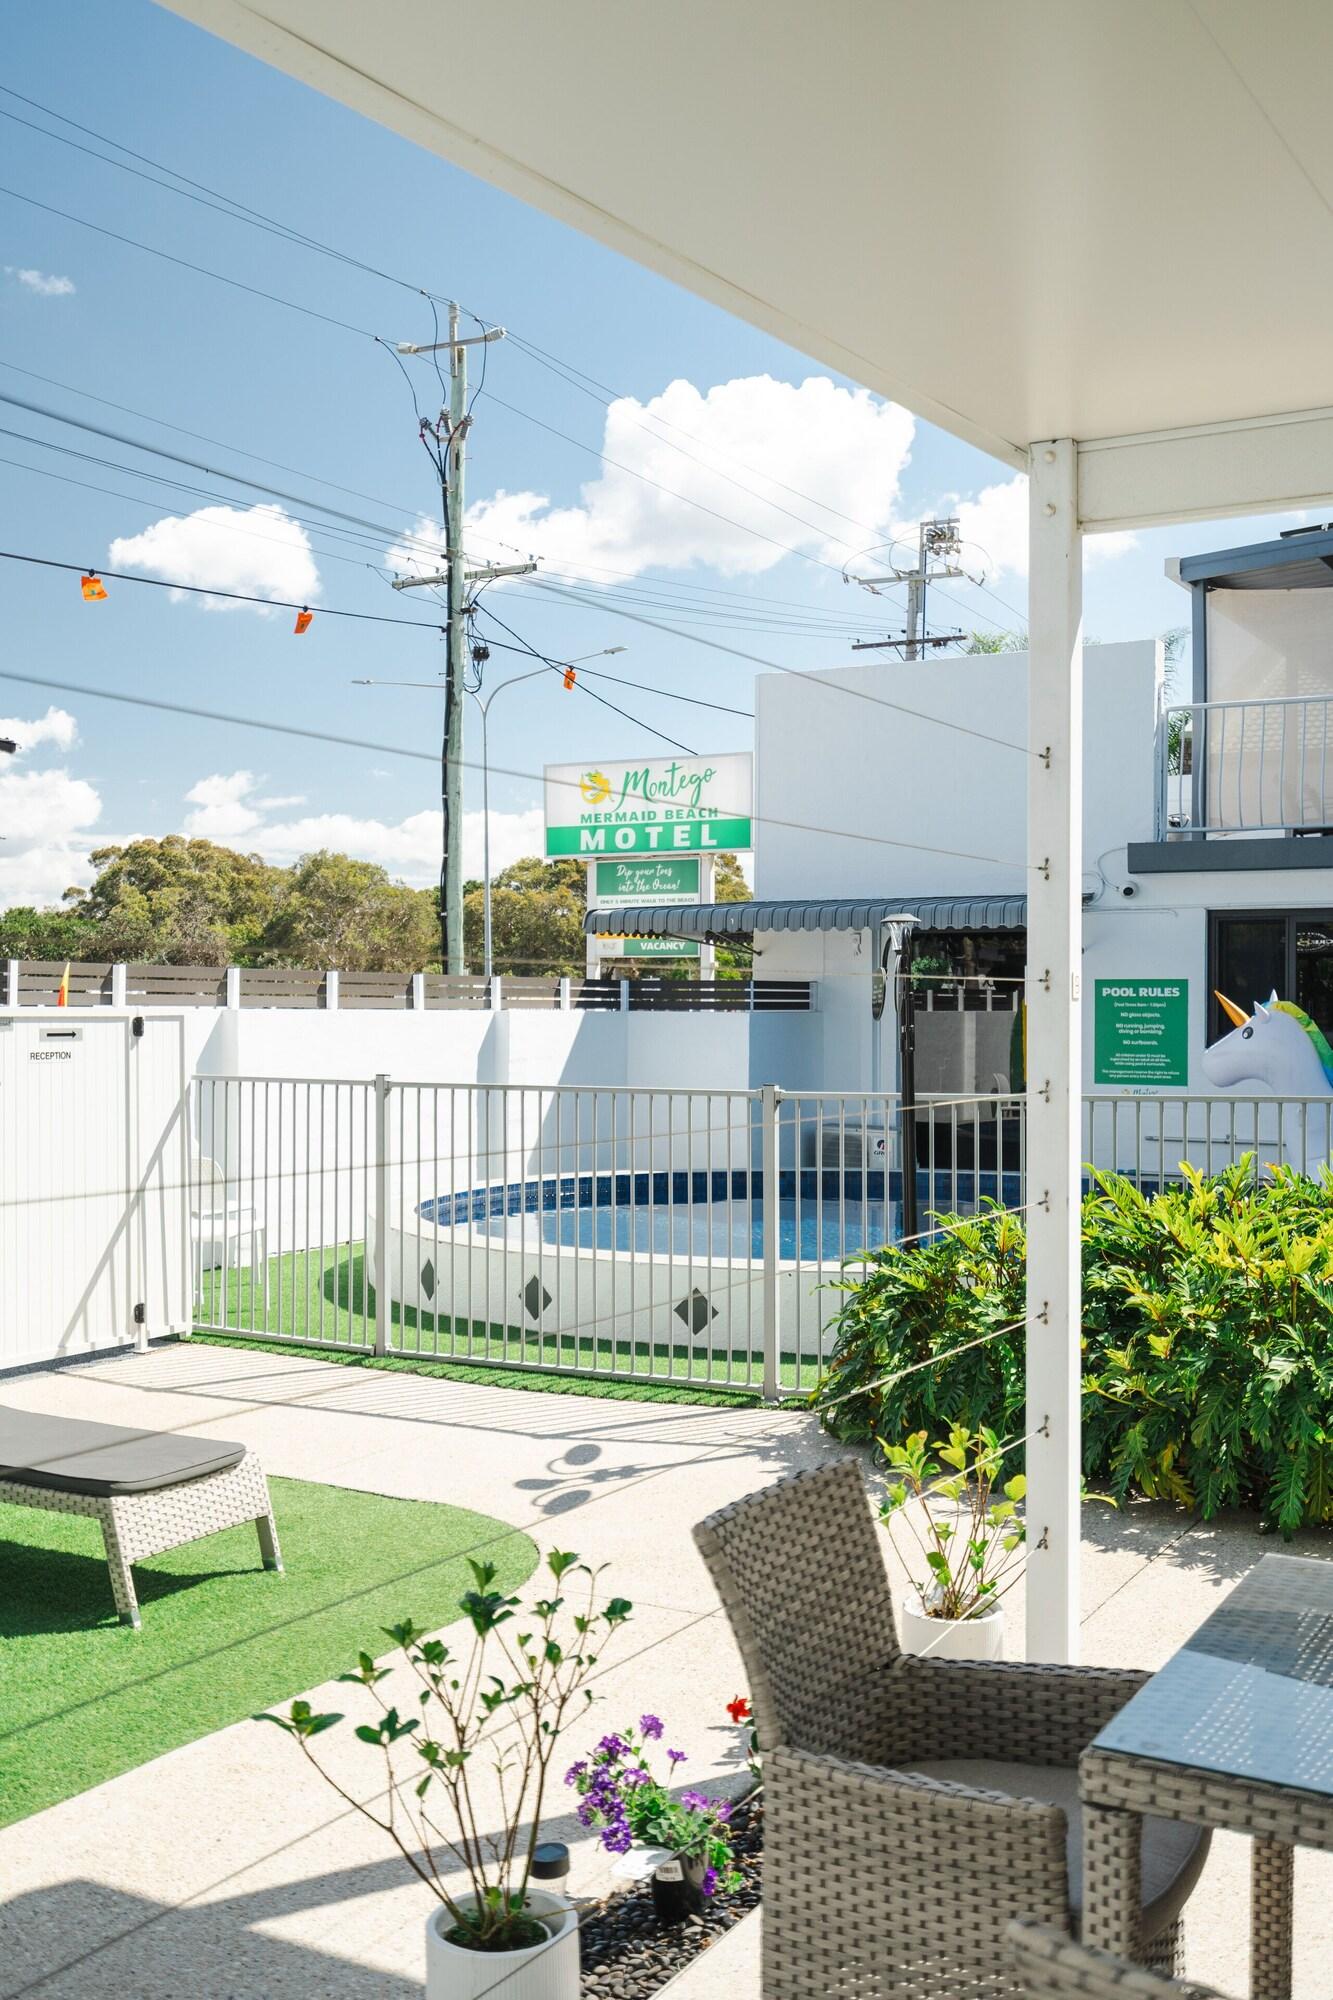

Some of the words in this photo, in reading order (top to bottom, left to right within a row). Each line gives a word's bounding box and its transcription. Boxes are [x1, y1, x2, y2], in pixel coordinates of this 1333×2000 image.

[611, 762, 717, 812] Montego
[581, 811, 656, 824] MERMAID
[665, 808, 718, 820] BEACH
[580, 824, 718, 851] MOTEL
[616, 864, 633, 880] Dip
[634, 869, 655, 883] your
[618, 879, 634, 892] into
[636, 878, 650, 892] the
[640, 942, 686, 951] VACANCY
[1102, 987, 1137, 997] POOL
[1139, 987, 1180, 997] RULES
[30, 1051, 72, 1060] RECEPTION
